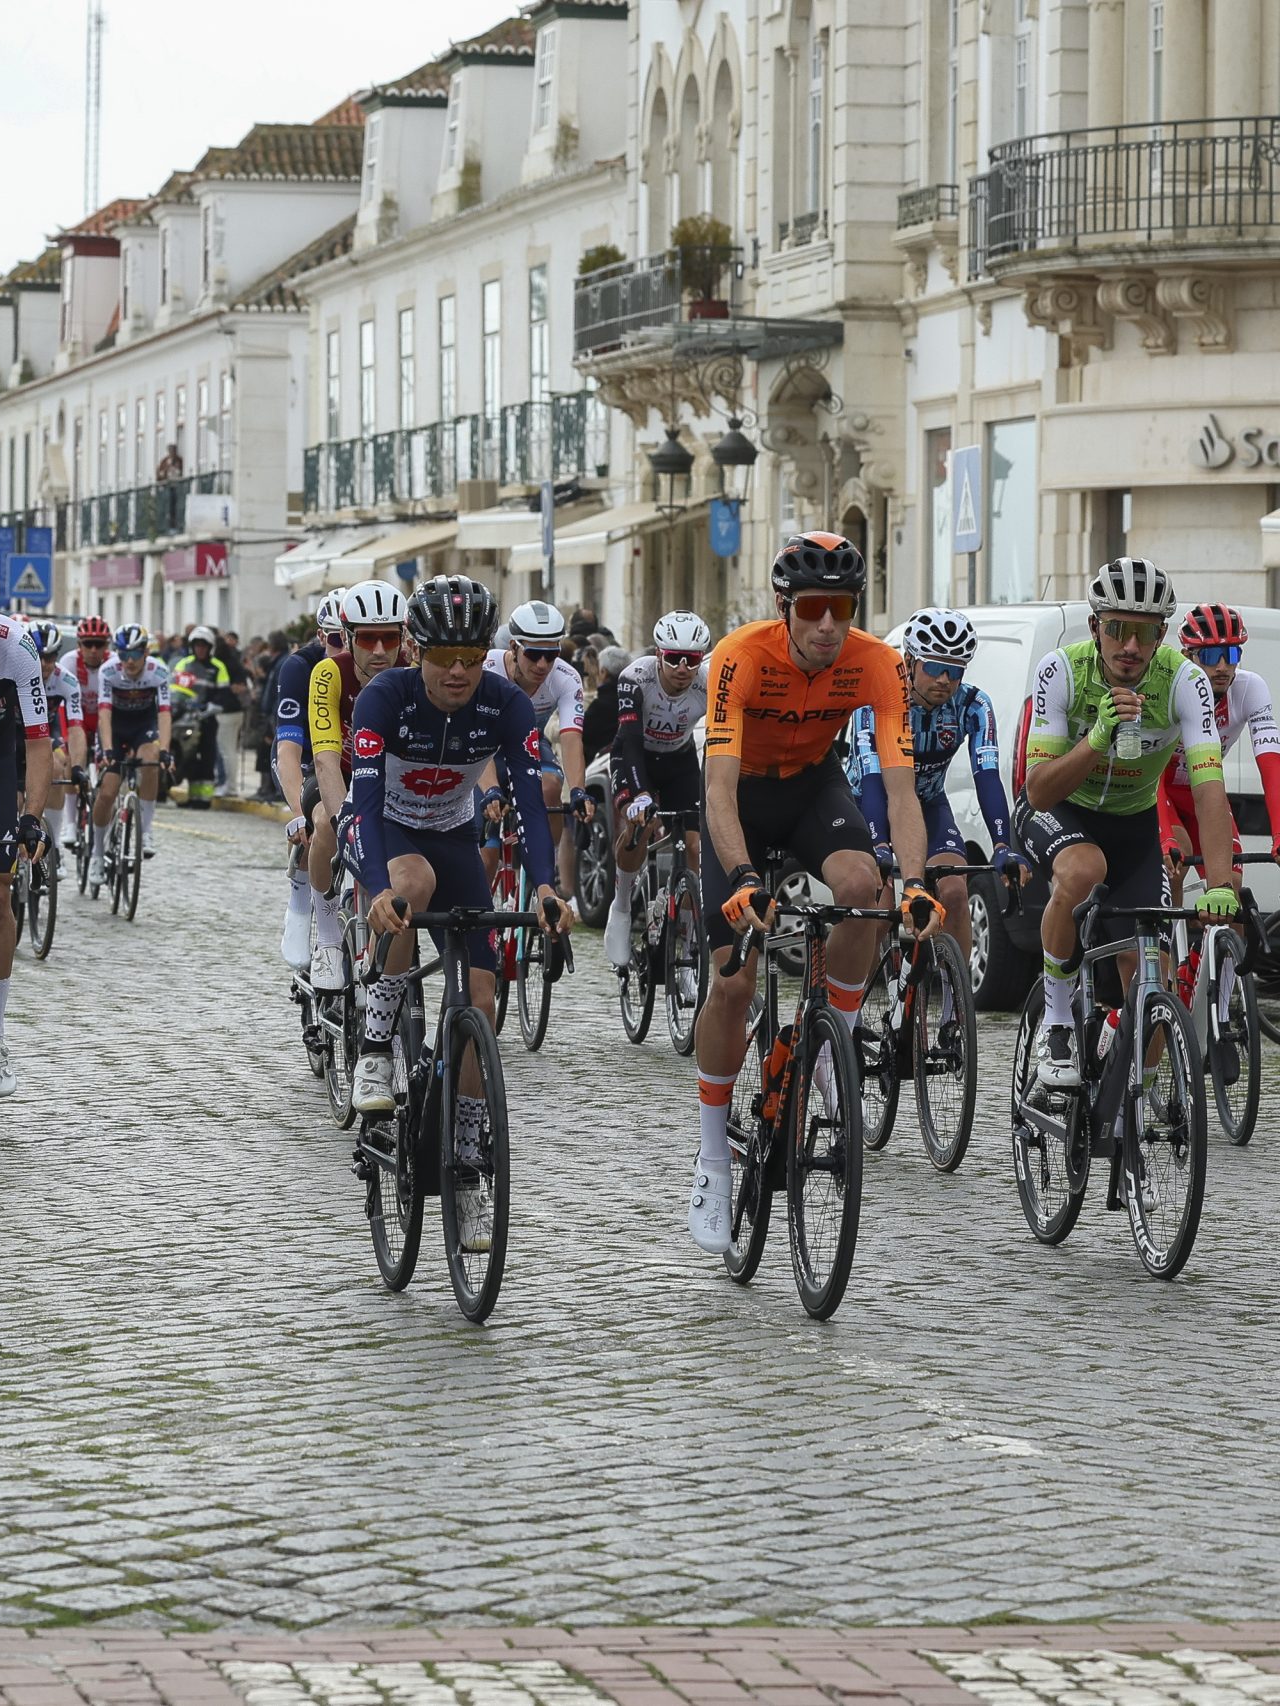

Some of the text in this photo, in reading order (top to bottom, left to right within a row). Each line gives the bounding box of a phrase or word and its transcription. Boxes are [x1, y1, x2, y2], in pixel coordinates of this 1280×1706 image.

[30, 676, 45, 715] BOSS
[313, 669, 333, 731] Cofidis
[714, 660, 738, 723] EFAPEL
[743, 707, 851, 724] EFAPEL
[895, 662, 910, 733] EFAPEL
[1035, 660, 1058, 717] tavfer
[1195, 677, 1215, 737] tavfer
[647, 719, 688, 733] UAE
[1045, 832, 1085, 856] mobel
[1125, 1167, 1169, 1268] newrace
